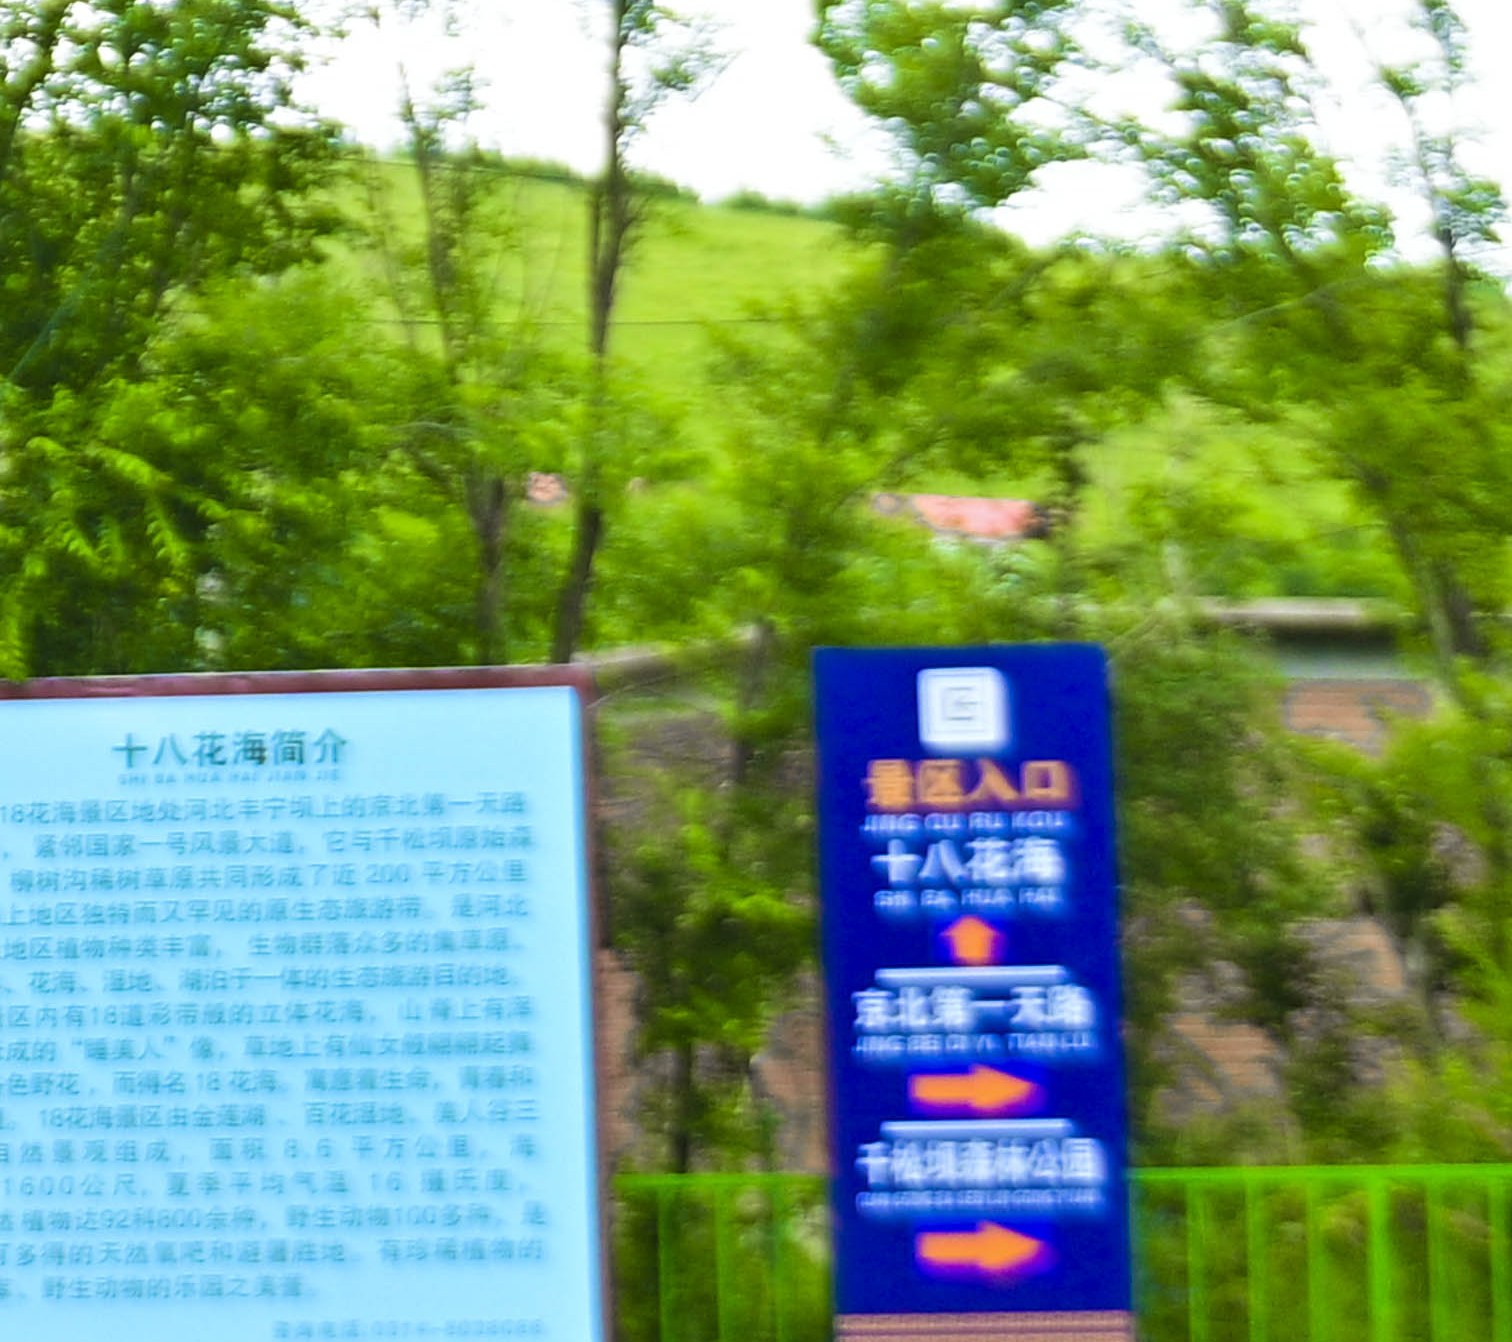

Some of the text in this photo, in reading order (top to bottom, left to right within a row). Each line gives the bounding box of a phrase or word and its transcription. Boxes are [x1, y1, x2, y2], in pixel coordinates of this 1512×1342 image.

[112, 729, 348, 769] 十八花海简介
[864, 758, 1072, 808] 景区入口
[870, 837, 1066, 887] 十八花海
[851, 984, 1098, 1030] 京北第一天路
